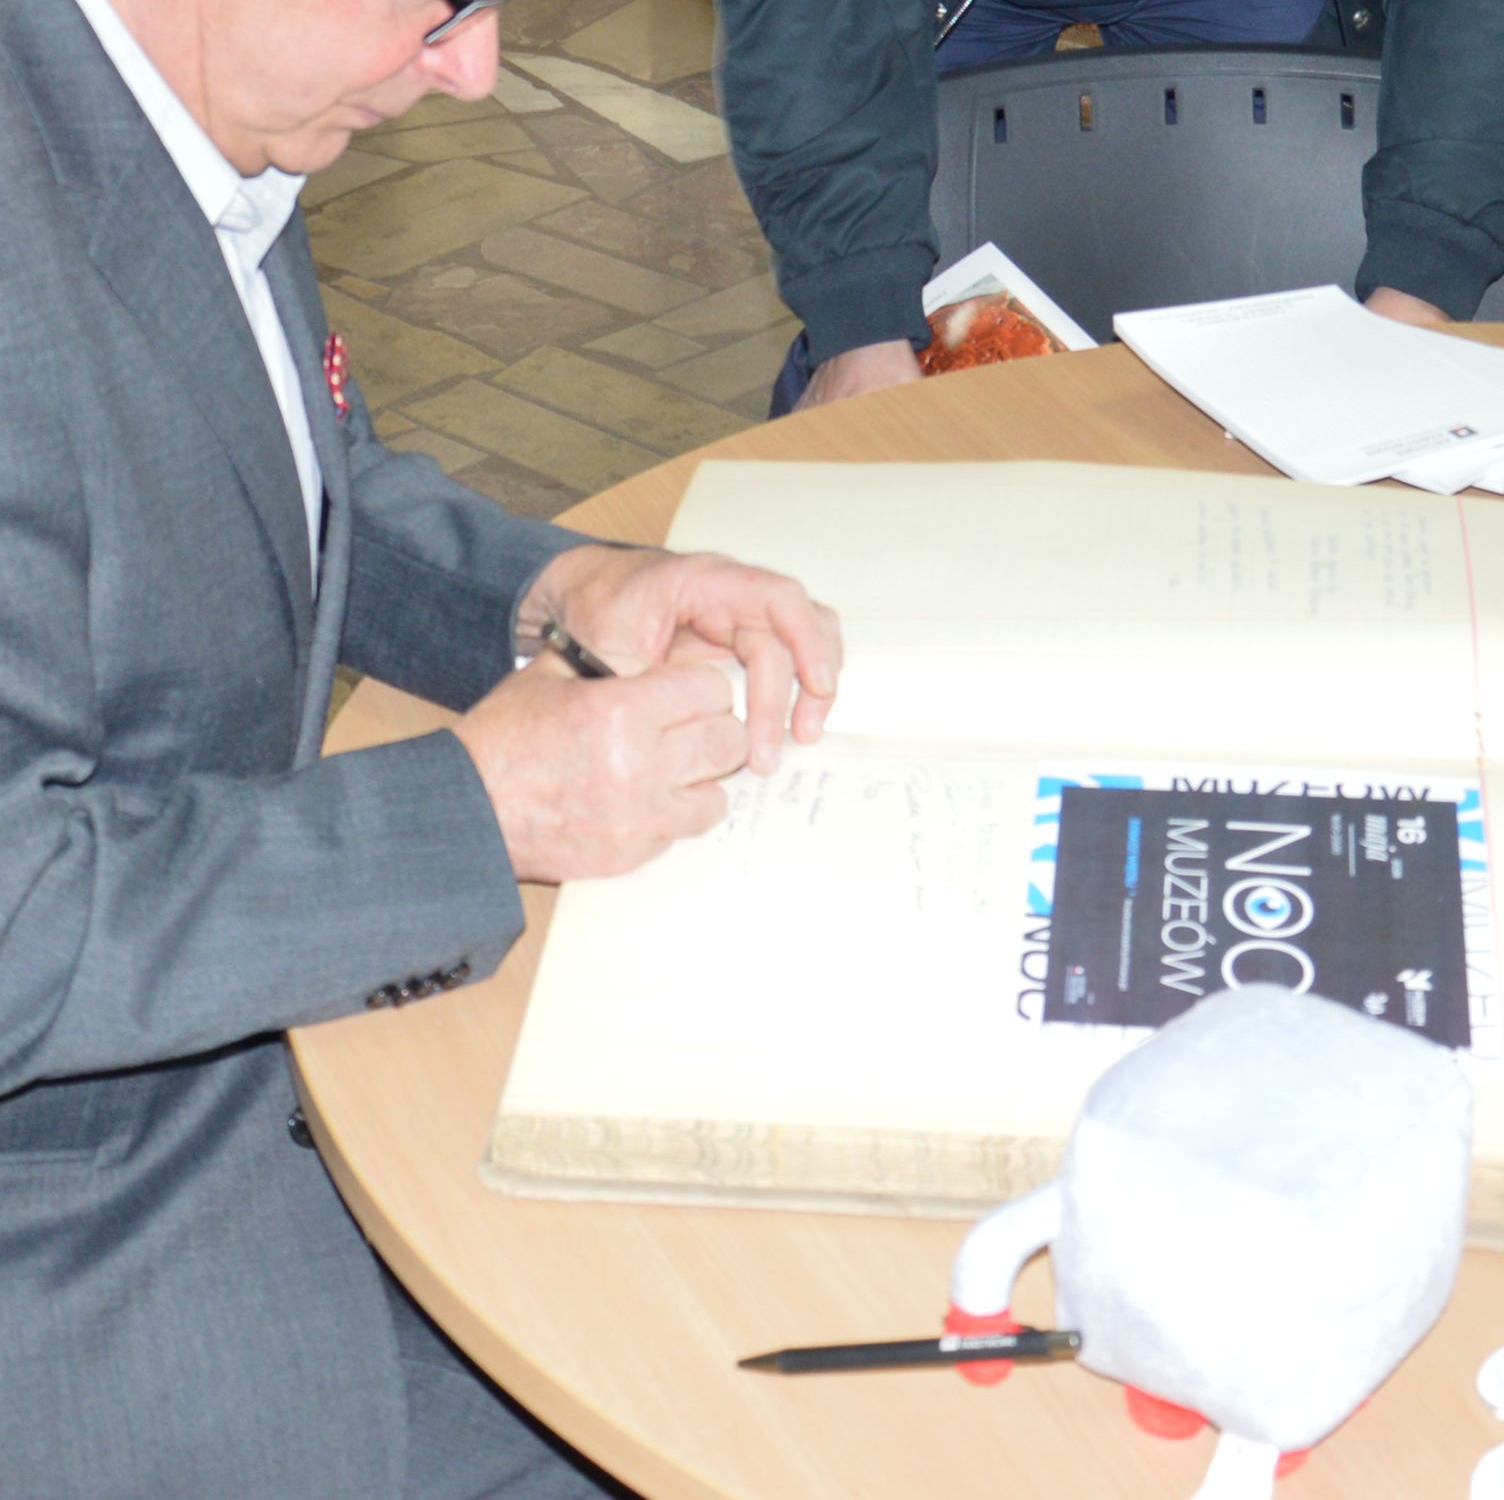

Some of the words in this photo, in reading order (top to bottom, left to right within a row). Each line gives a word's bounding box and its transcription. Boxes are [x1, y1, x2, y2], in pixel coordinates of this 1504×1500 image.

[1359, 813, 1396, 863] maja
[1395, 815, 1427, 845] 16
[1159, 817, 1217, 997] MUZEÓW
[1221, 820, 1316, 1001] NOC
